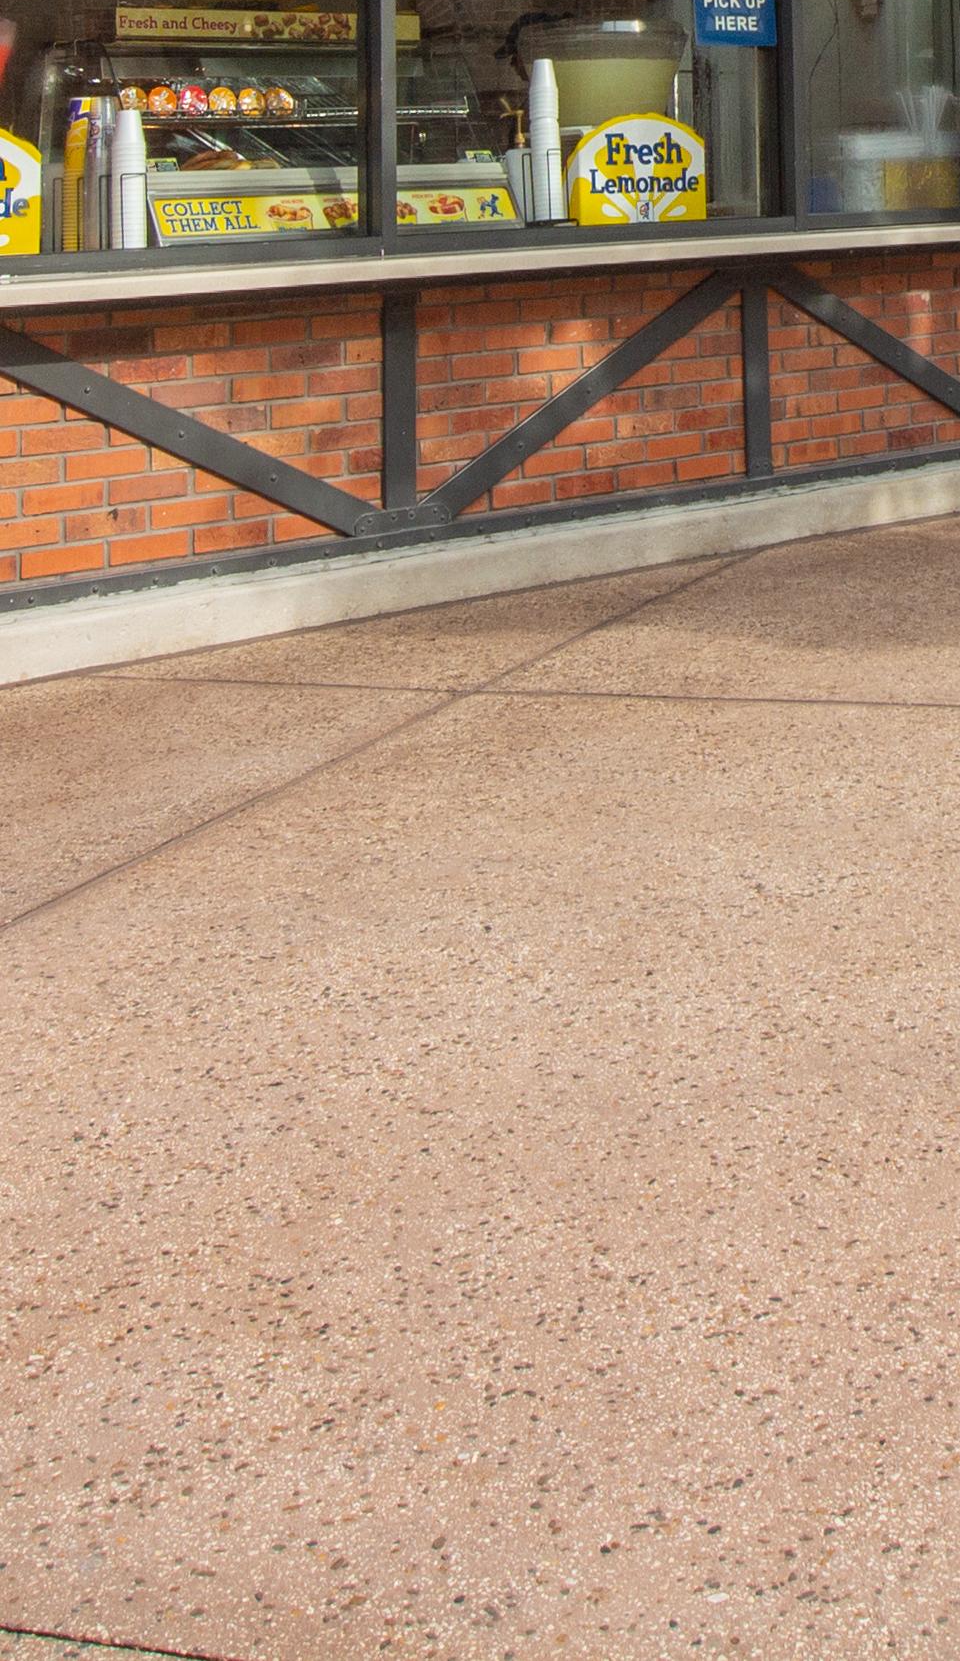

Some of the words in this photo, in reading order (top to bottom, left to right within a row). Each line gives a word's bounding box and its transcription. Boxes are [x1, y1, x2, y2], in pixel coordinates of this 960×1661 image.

[119, 14, 158, 30] Fresh
[161, 16, 189, 30] and
[191, 17, 238, 35] Cheesy
[714, 15, 759, 32] HERE
[604, 131, 684, 166] Fresh
[589, 166, 700, 194] Lemonade
[162, 199, 243, 217] COLLECT
[165, 217, 219, 233] THEM
